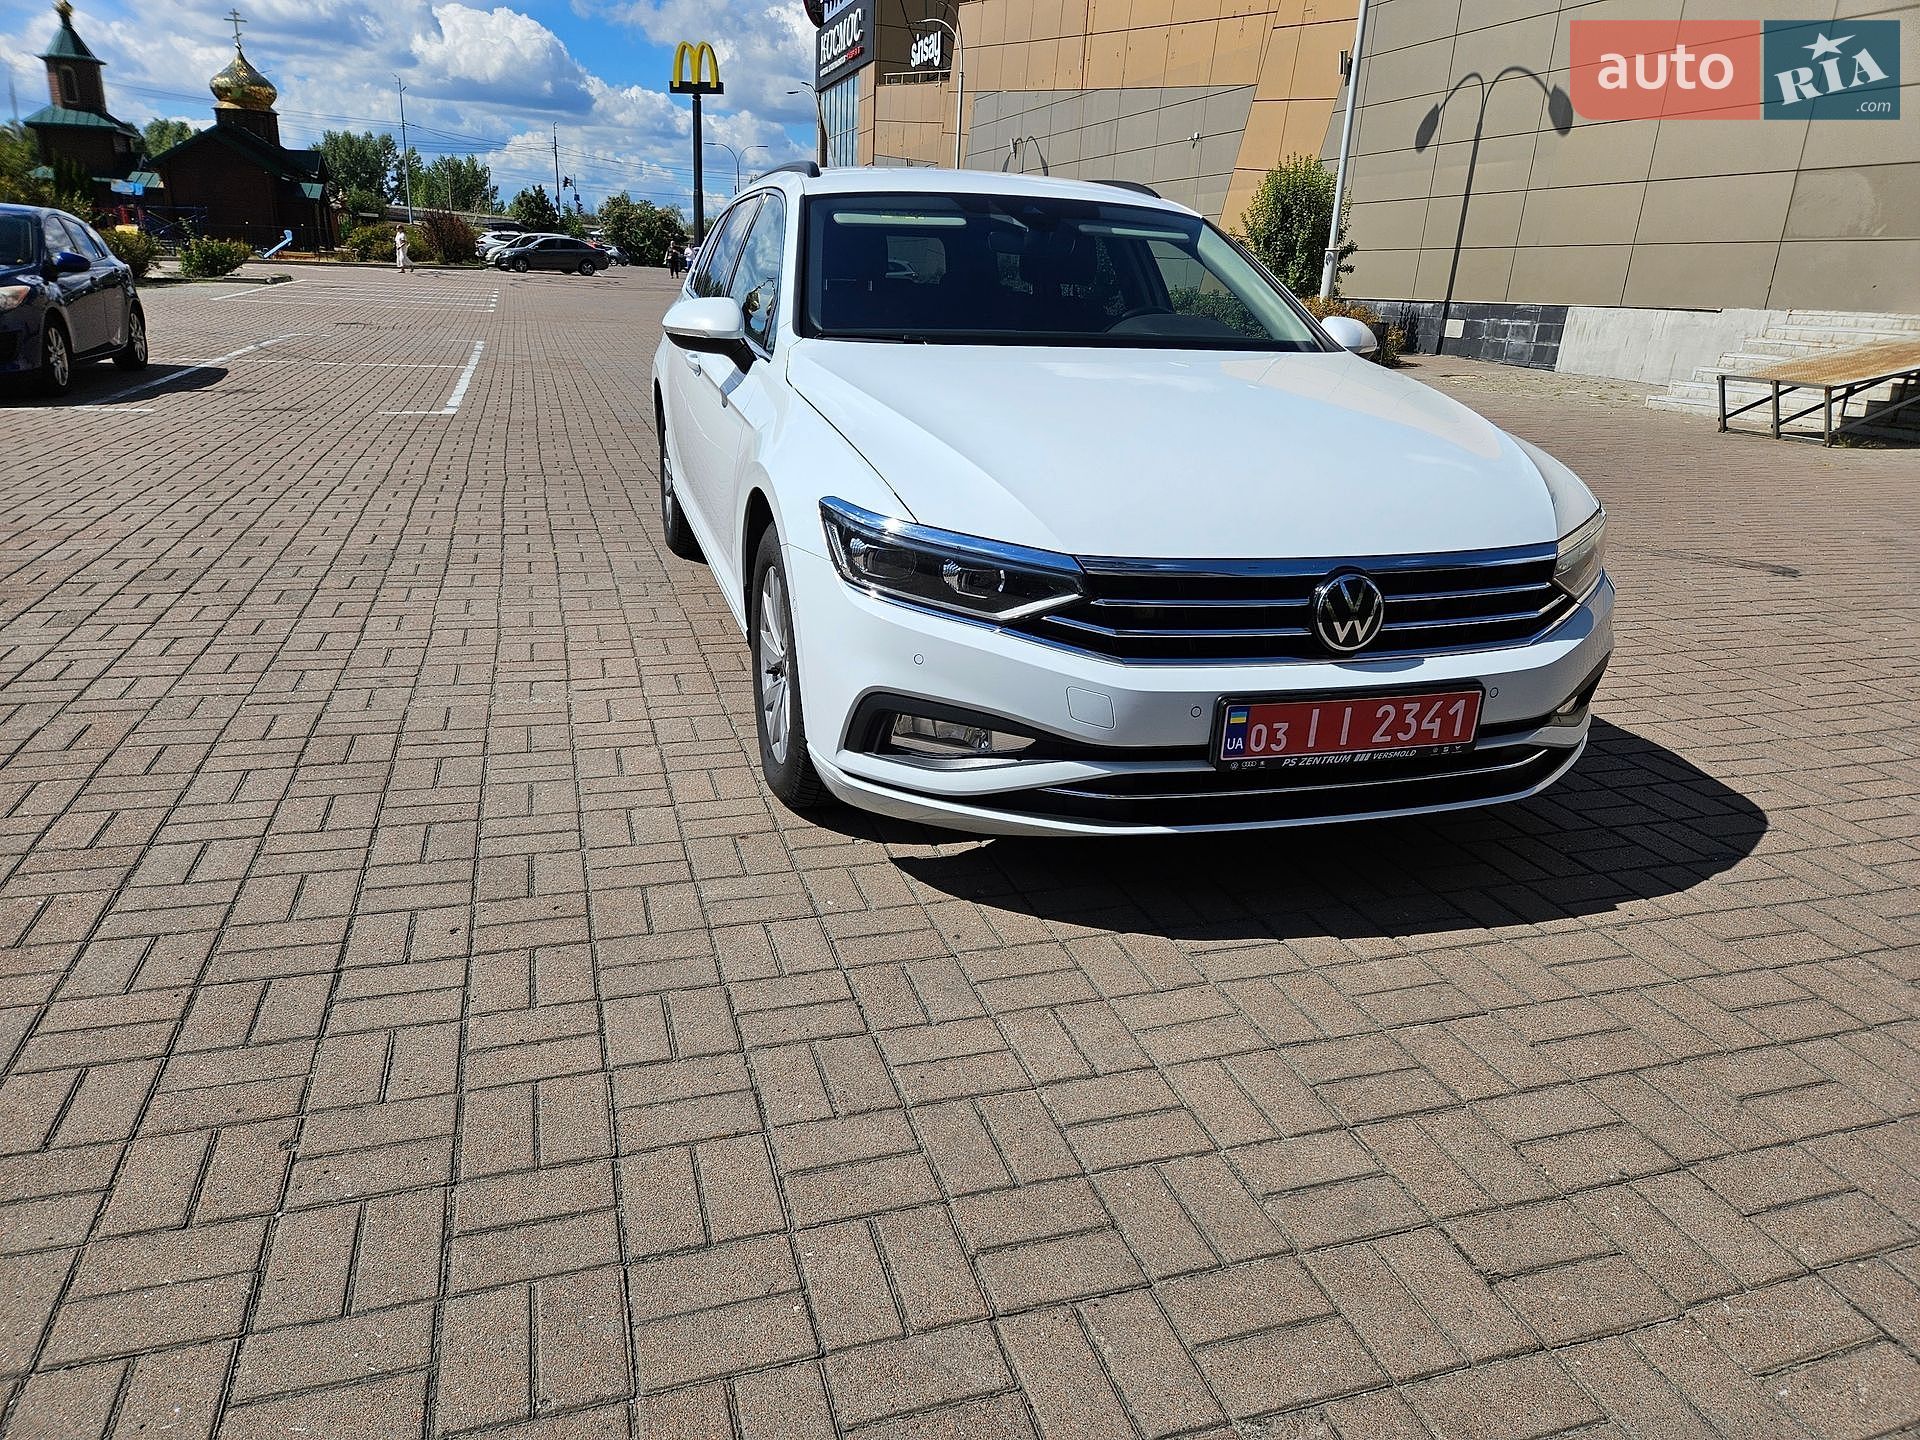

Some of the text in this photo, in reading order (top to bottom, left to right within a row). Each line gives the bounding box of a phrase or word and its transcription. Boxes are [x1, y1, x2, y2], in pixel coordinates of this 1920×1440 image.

[911, 31, 941, 67] sinsay
[1249, 723, 1289, 752] 03
[1372, 699, 1466, 743] 2341
[1227, 737, 1244, 750] UA
[1281, 750, 1417, 767] PS ZENTRUM VERSMOLD
